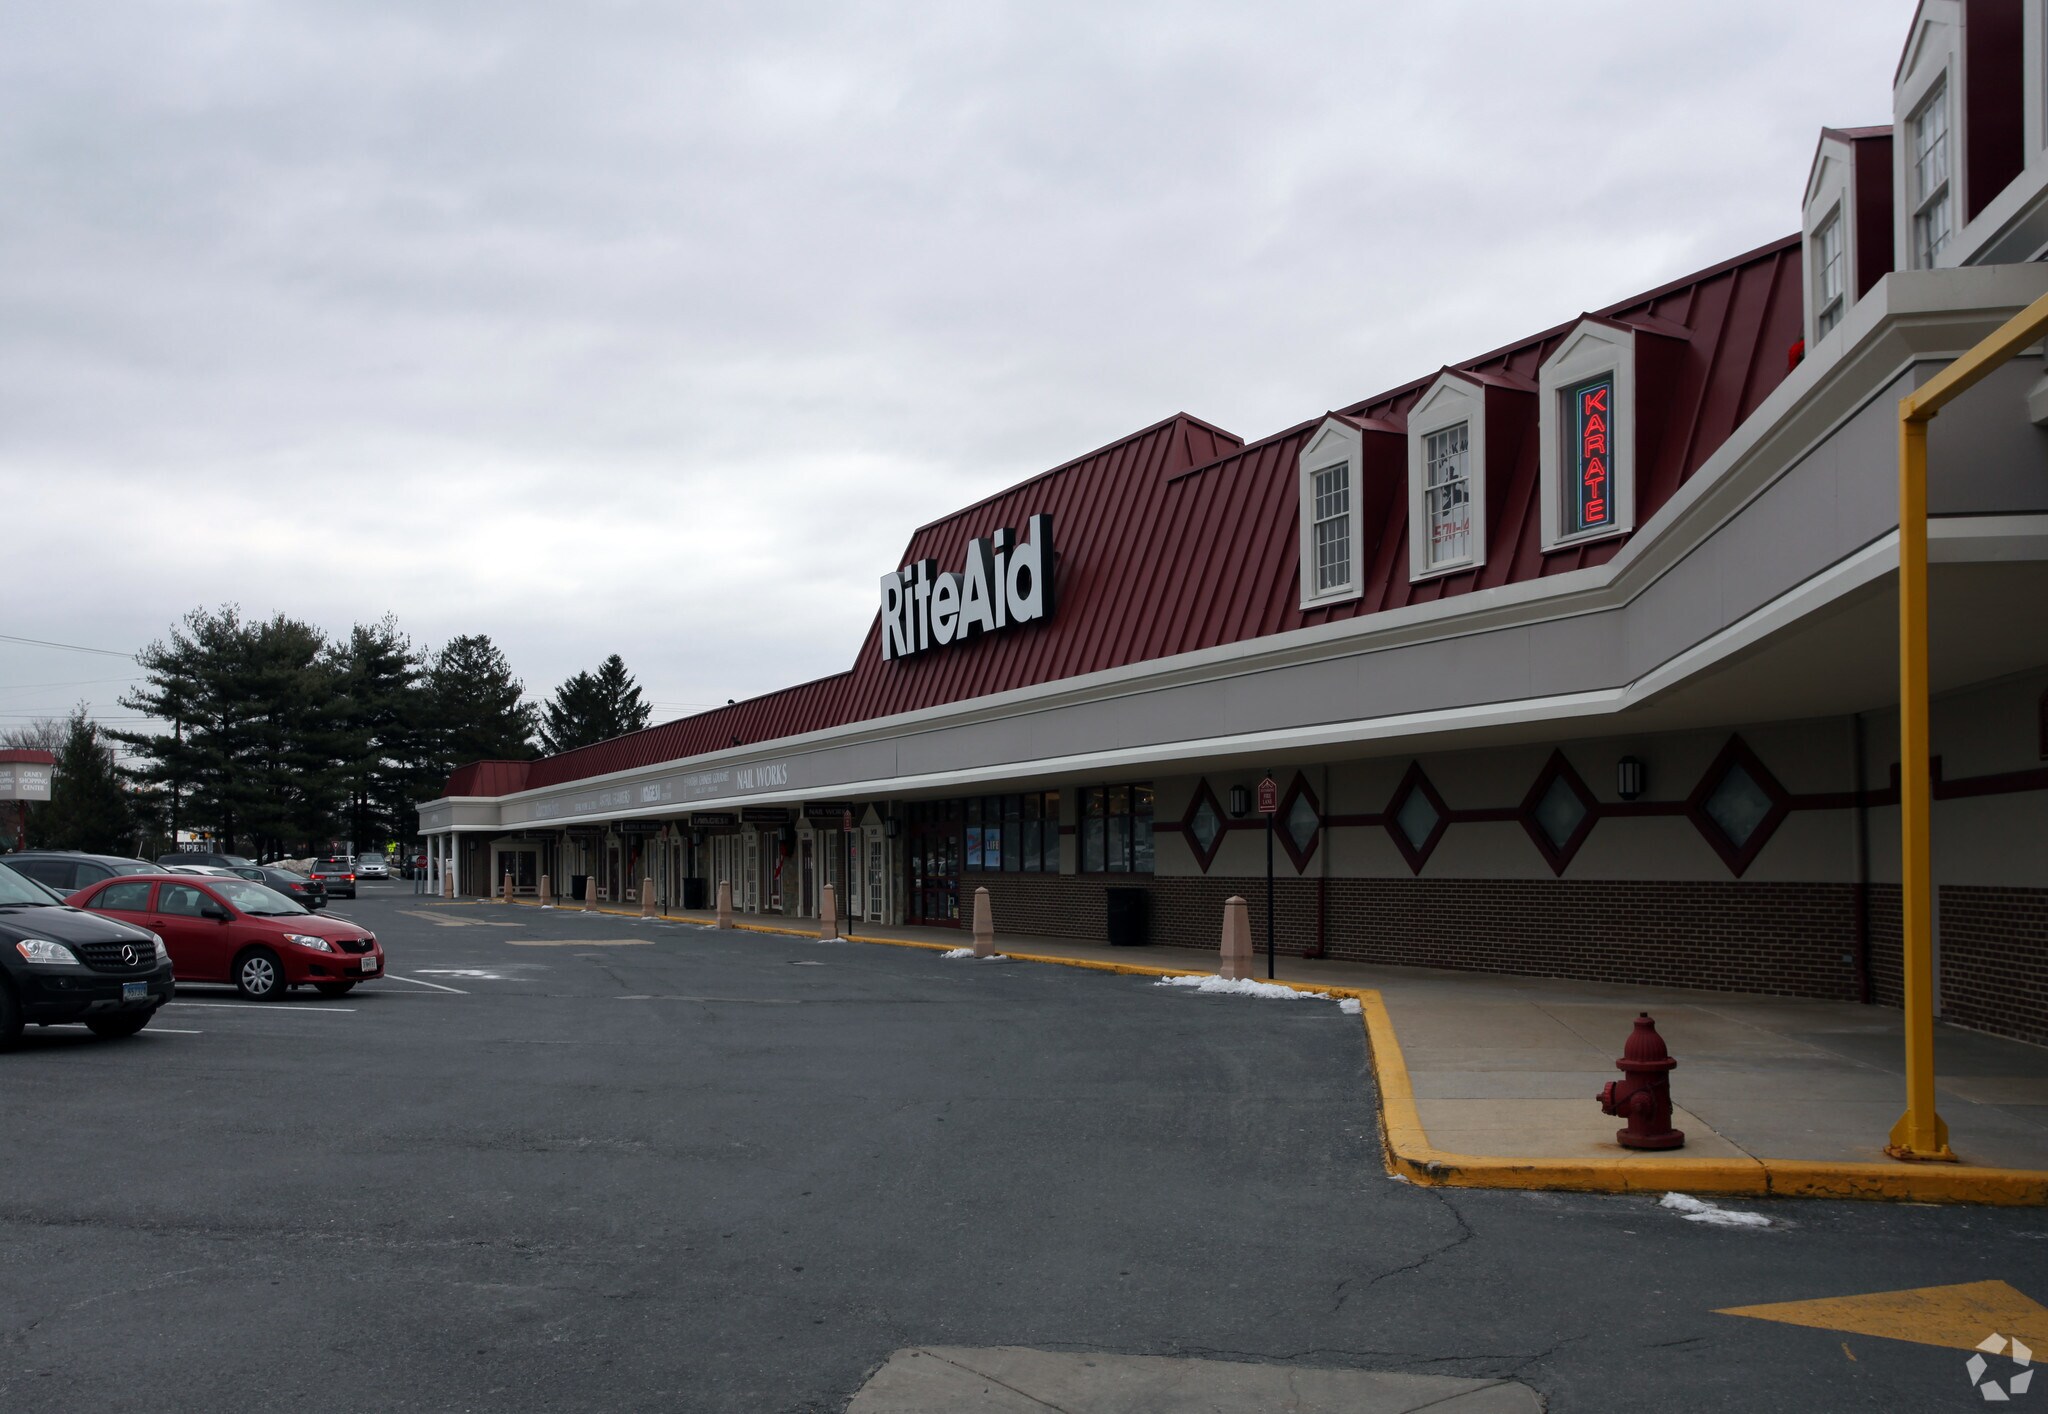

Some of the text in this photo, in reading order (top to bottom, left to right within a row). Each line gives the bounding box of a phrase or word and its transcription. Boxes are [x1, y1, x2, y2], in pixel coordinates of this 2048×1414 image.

[1584, 388, 1607, 523] KARATE
[880, 513, 1045, 661] RiteAid
[736, 763, 788, 790] NAIL WORKS
[809, 808, 824, 816] NAIL
[986, 841, 1000, 850] LIFE
